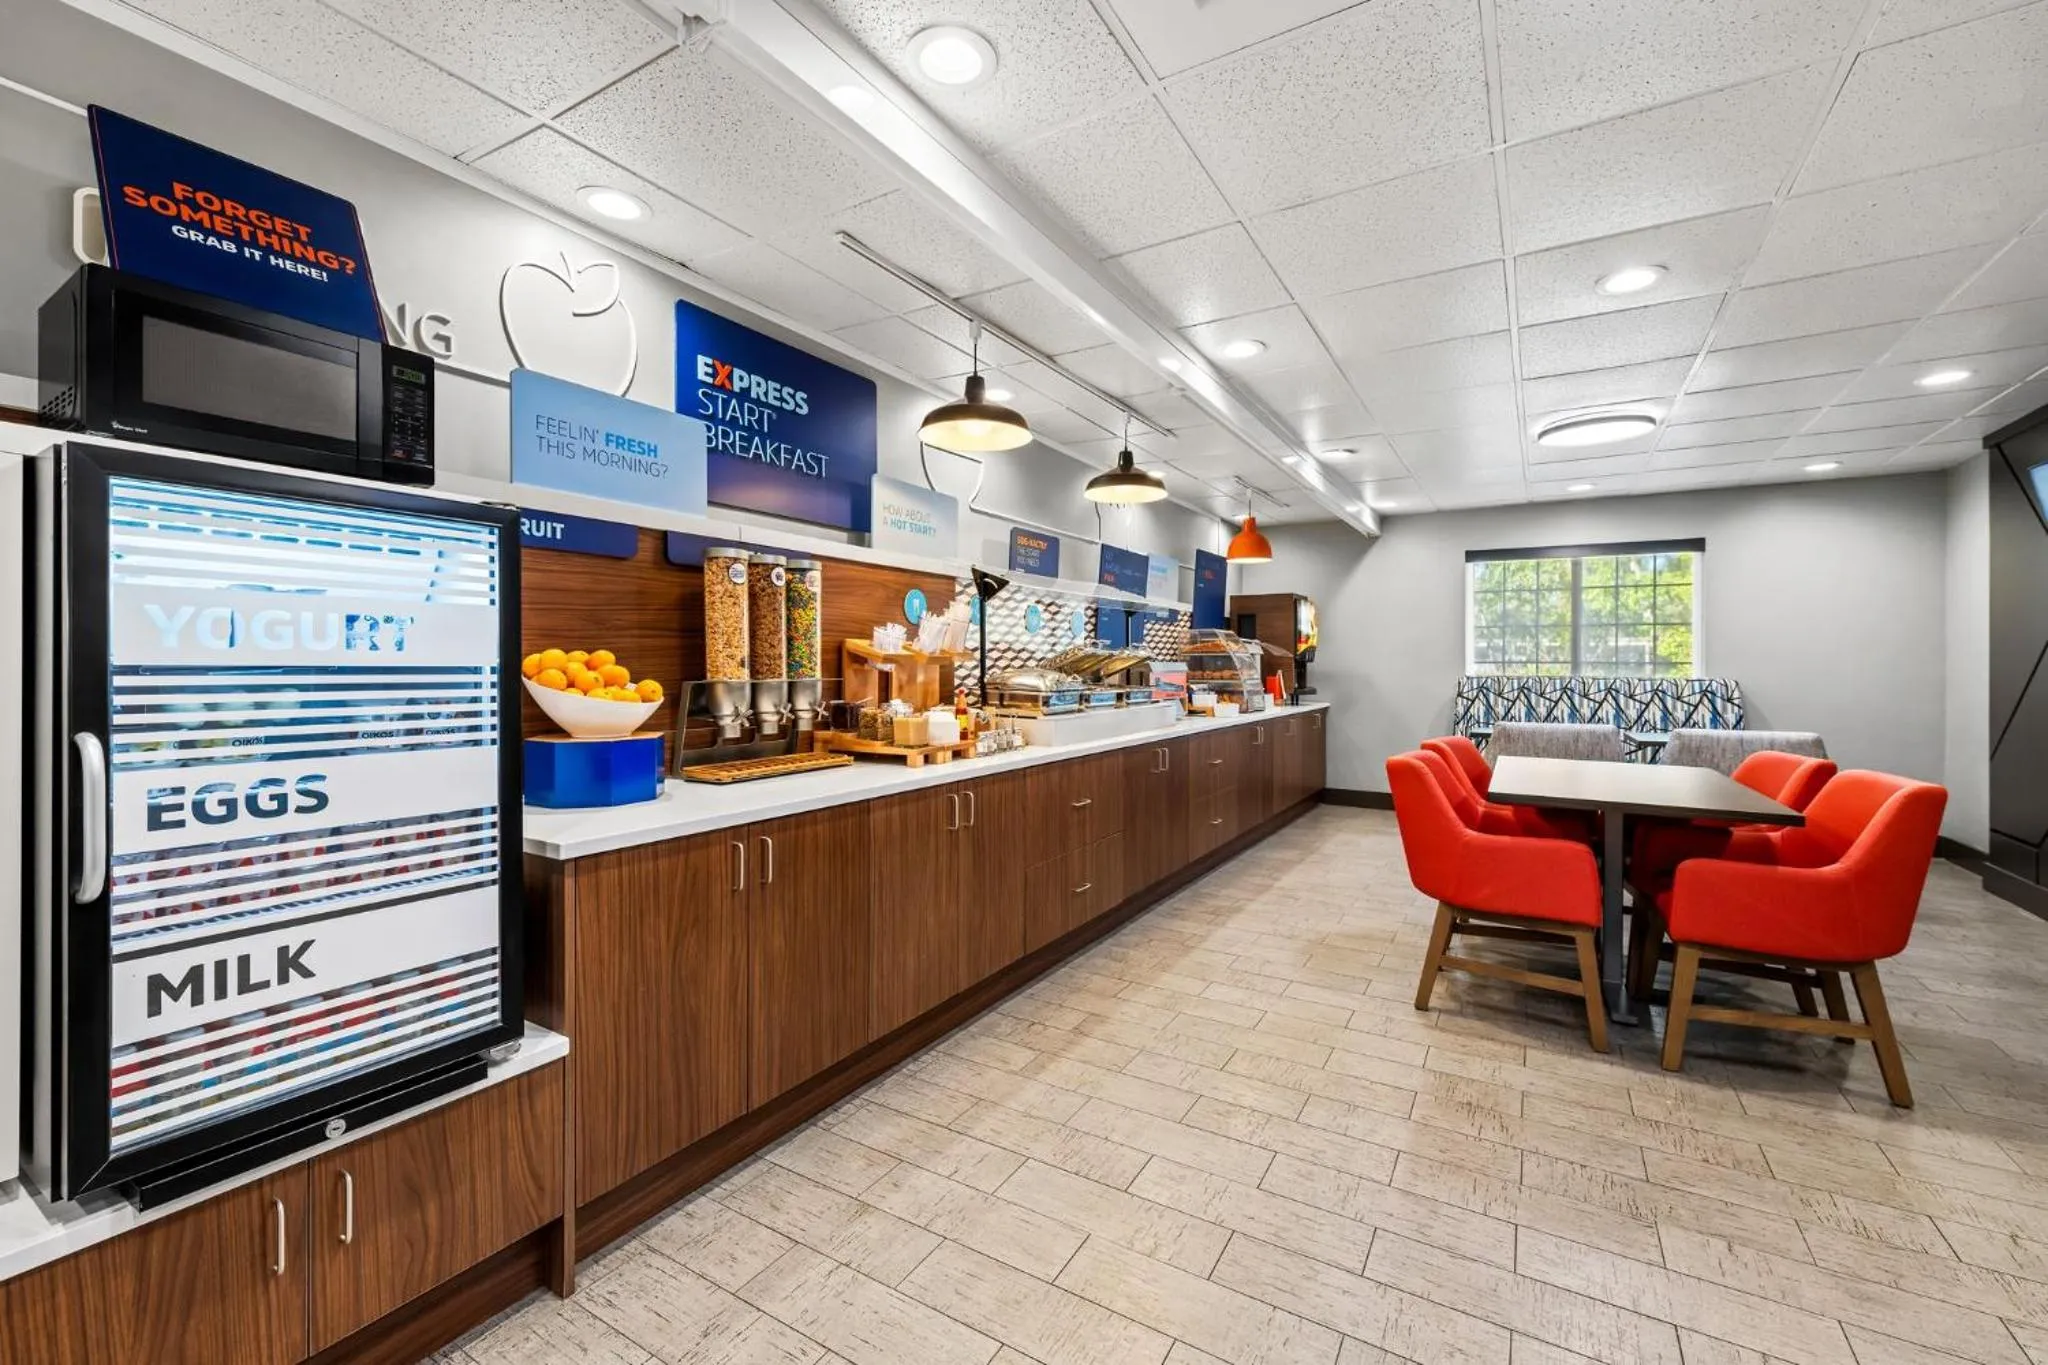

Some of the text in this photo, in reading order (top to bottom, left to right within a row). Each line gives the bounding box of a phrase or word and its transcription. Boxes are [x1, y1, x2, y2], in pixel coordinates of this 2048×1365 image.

[122, 185, 357, 275] SOMETHING?
[172, 181, 312, 242] FORGET
[171, 224, 329, 282] GRAB IT HERE!
[697, 354, 810, 415] EXPRESS
[698, 388, 773, 433] START
[535, 414, 658, 458] FEELIN' FRESH
[535, 434, 669, 478] THIS MORNING?
[704, 421, 830, 478] BREAKFAST
[882, 502, 904, 516] HOW
[890, 517, 908, 530] HOT
[143, 604, 416, 652] YOGURT
[361, 731, 395, 739] OIKOS
[147, 774, 329, 832] EGGS
[147, 939, 317, 1019] MILK
